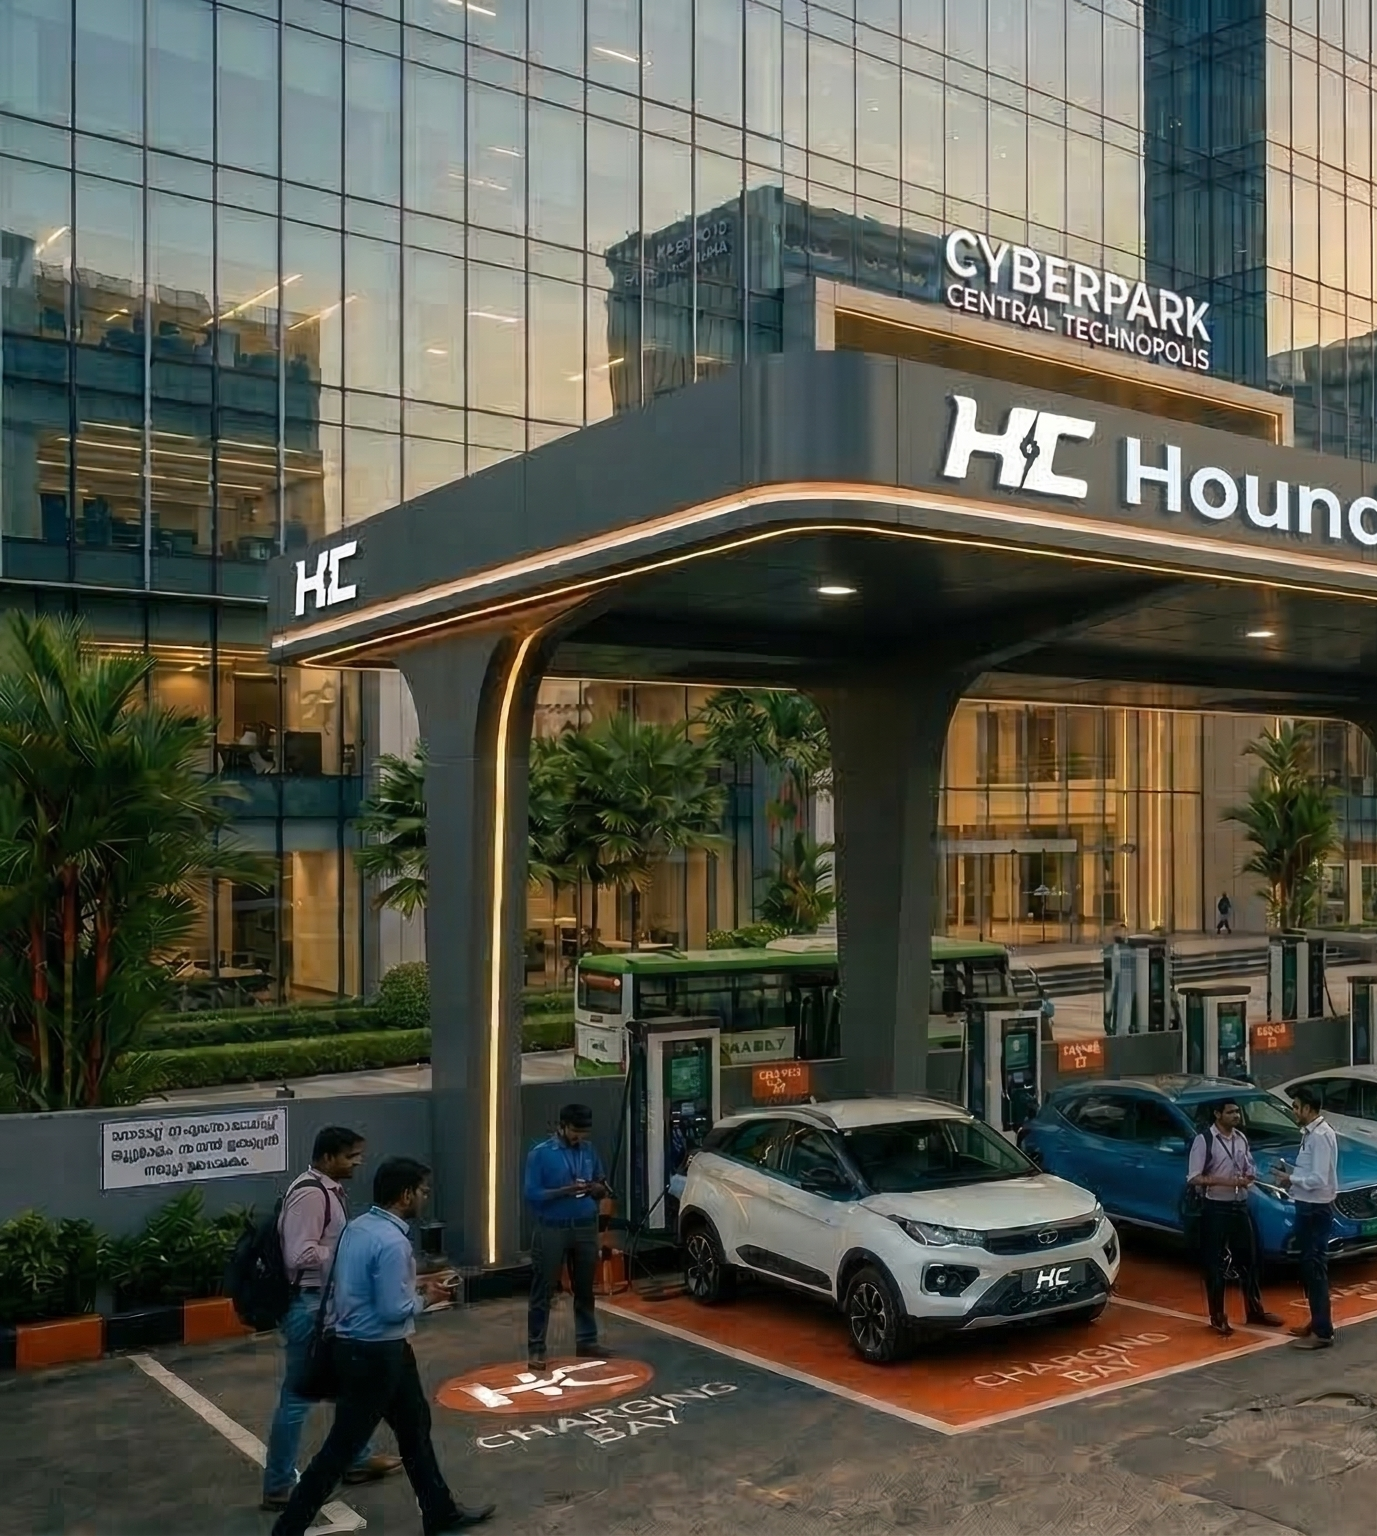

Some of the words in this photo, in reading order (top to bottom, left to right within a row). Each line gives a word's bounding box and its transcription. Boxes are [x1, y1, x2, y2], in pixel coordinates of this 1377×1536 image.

[946, 229, 1211, 342] CYBERPARK
[947, 284, 1055, 331] CENTRAL
[1063, 313, 1210, 370] TECHNOPOLIS
[1035, 1266, 1072, 1289] HC
[1058, 1354, 1141, 1383] BAY
[476, 1382, 739, 1449] CHARGING
[583, 1409, 680, 1445] BAY
